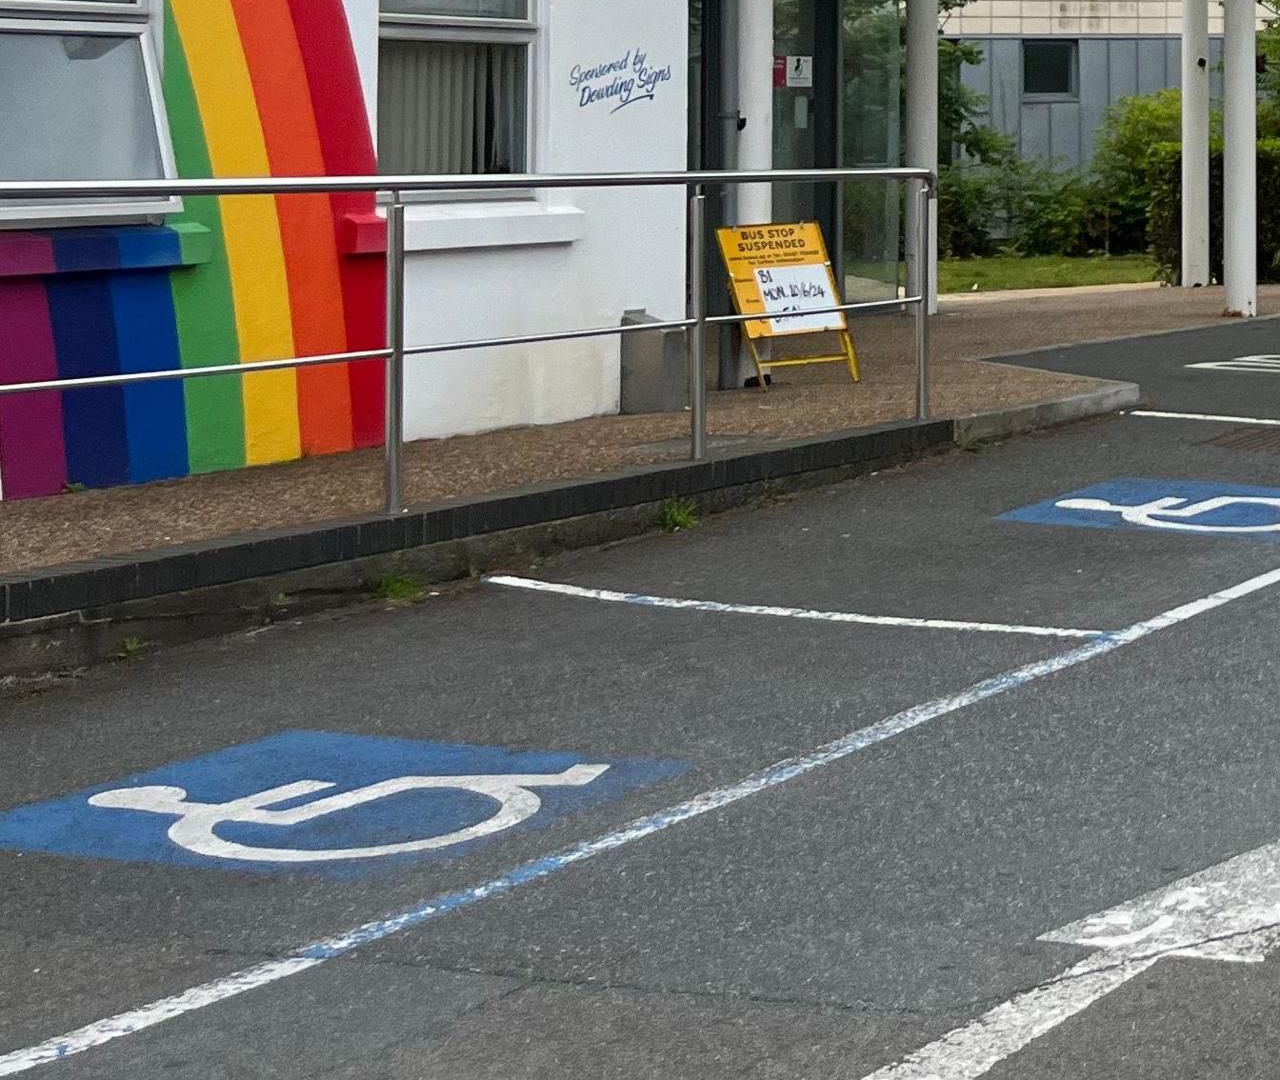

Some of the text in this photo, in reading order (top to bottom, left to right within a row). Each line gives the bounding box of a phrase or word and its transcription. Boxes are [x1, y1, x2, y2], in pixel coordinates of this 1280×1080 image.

[569, 47, 646, 92] Sponsored by
[579, 65, 671, 107] Dowding Signs
[737, 239, 806, 252] SUSPENDED
[740, 228, 795, 240] BUS STOP
